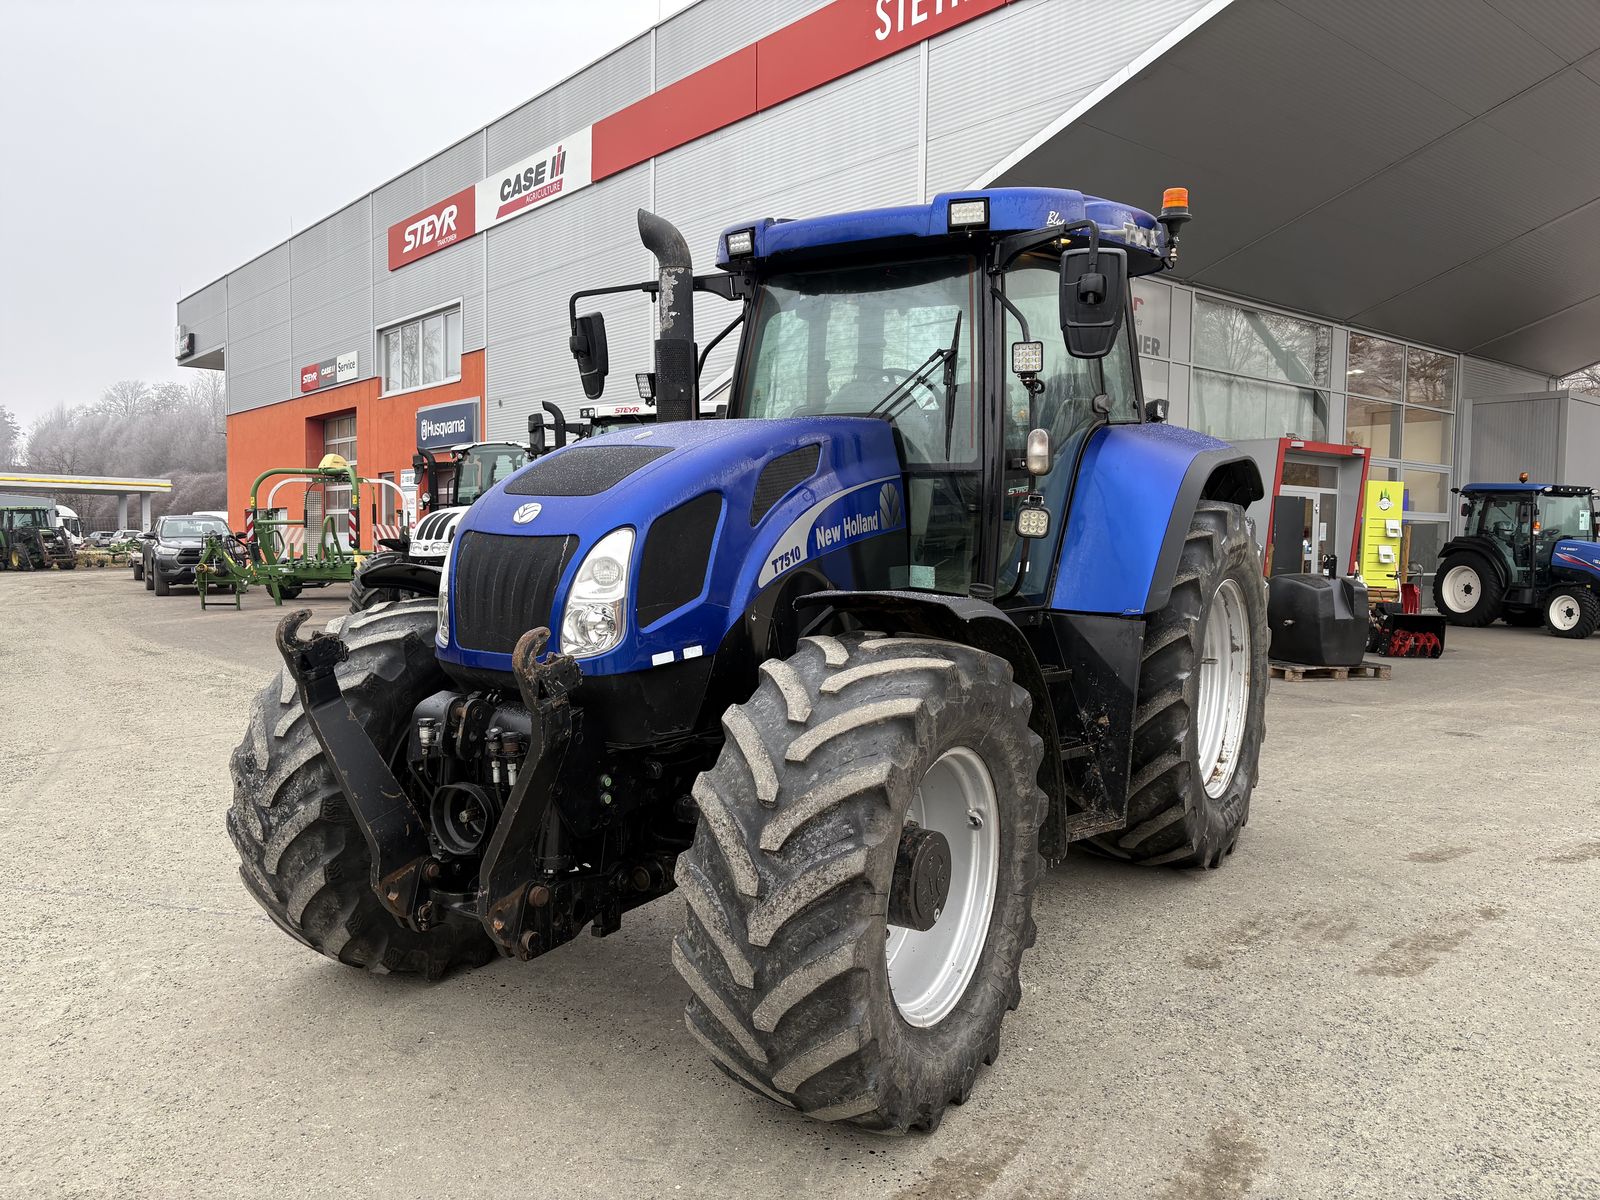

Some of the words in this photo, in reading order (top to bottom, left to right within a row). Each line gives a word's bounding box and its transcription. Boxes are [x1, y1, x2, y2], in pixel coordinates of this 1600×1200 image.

[499, 160, 547, 202] CASE
[525, 181, 561, 204] AGRICULTURE
[402, 204, 458, 254] STEYR
[337, 360, 356, 373] Service
[614, 406, 640, 414] STEYR
[427, 419, 466, 438] Husqvarna
[815, 524, 841, 550] New
[843, 511, 879, 539] Holland
[771, 546, 801, 575] T7510
